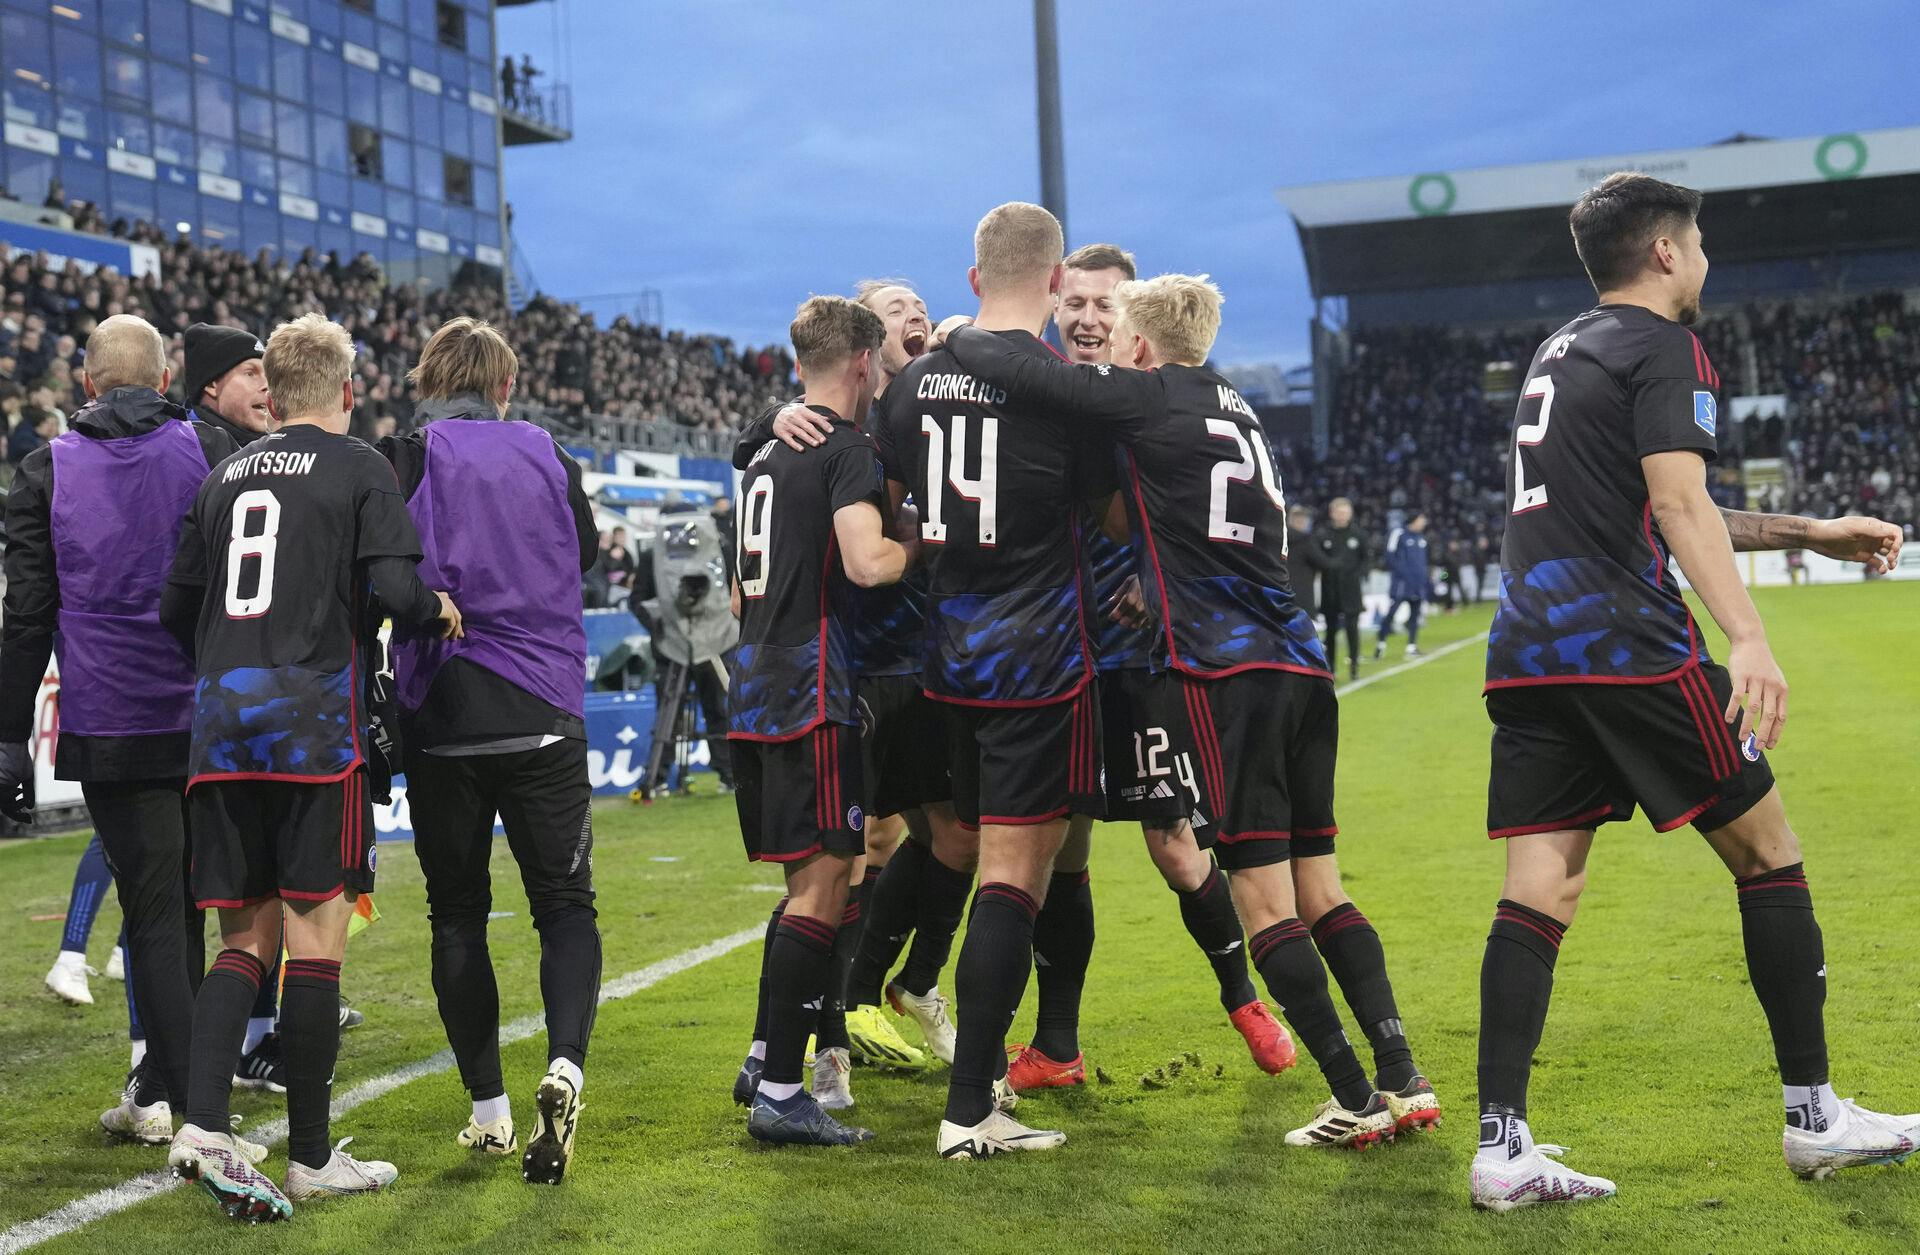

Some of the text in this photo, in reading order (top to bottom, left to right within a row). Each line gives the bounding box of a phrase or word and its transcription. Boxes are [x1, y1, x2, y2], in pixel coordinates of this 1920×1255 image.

[222, 451, 317, 484] MATTSSON
[921, 414, 999, 548] 14
[1205, 417, 1289, 560] 24
[1511, 374, 1555, 515] 2
[225, 489, 281, 620] 8
[1133, 726, 1171, 779] 12
